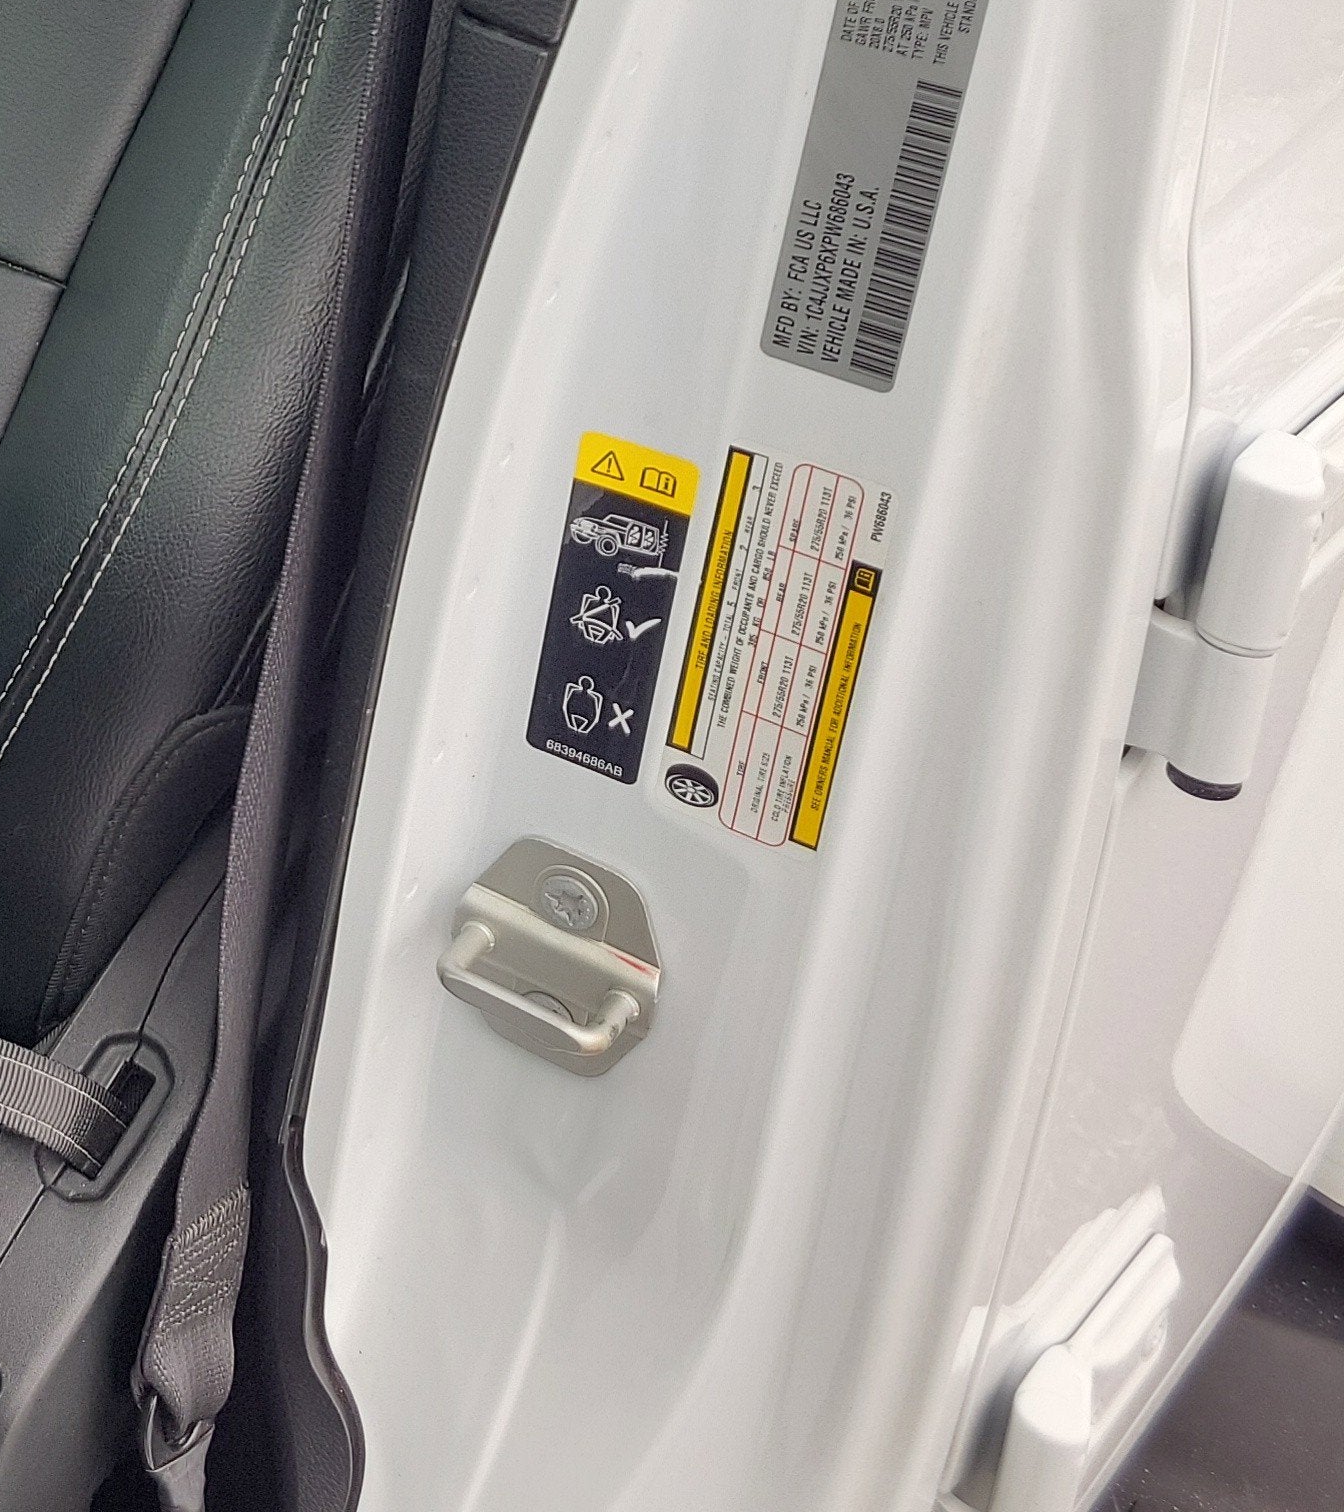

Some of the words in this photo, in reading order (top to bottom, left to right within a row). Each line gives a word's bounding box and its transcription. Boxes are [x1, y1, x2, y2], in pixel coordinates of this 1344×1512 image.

[846, 0, 860, 14] OF
[918, 7, 933, 28] MPV
[938, 0, 959, 41] VEHICLE
[840, 16, 856, 42] DATE
[854, 15, 871, 46] GAWR
[899, 23, 913, 40] 250
[895, 43, 909, 56] AT
[911, 31, 928, 60] TYPE:
[932, 42, 949, 65] THIS
[799, 198, 822, 226] LLC
[851, 183, 879, 230] U.S.A.
[794, 228, 815, 250] US
[804, 171, 855, 322] 1C4JJXP6XPW686043
[845, 232, 868, 255] IN:
[787, 253, 810, 282] FCA
[834, 257, 862, 301] MADE
[780, 286, 802, 312] BY:
[772, 314, 796, 348] MFD
[796, 324, 819, 356] VIN:
[820, 303, 851, 363] VEHICLE
[769, 461, 783, 490] EXCEED
[763, 491, 776, 516] NEVER
[870, 490, 892, 542] PW686043
[756, 517, 770, 547] SHOULD
[809, 507, 828, 552] 275/55R20
[820, 486, 832, 507] 113T
[712, 528, 733, 590] INFORMATION
[751, 547, 764, 574] CARGO
[747, 574, 758, 591] AND
[751, 615, 761, 628] KG
[756, 596, 765, 608] OR
[766, 549, 775, 560] LB
[775, 581, 785, 603] REAR
[704, 590, 720, 629] LOADING
[726, 599, 737, 608] 5
[737, 592, 754, 635] OCCUPANTS
[790, 592, 808, 636] 275/55R20
[800, 571, 813, 592] 113T
[700, 629, 711, 649] AND
[735, 635, 744, 646] OF
[841, 620, 862, 673] INFORMATION
[695, 649, 706, 670] TIRE
[728, 646, 741, 675] WEIGHT
[756, 660, 767, 685] FRONT
[720, 675, 735, 713] COMBINED
[771, 674, 789, 718] 275/55R20
[781, 654, 793, 676] 113T
[831, 673, 849, 716] ADDITIONAL
[716, 713, 727, 729] THE
[828, 716, 839, 733] FOR
[545, 739, 623, 777] 68394686AB
[820, 734, 835, 765] MANUAL
[778, 753, 792, 789] INFLATION
[774, 788, 784, 804] TIRE
[810, 796, 820, 811] SEE
[770, 803, 781, 822] COLD
